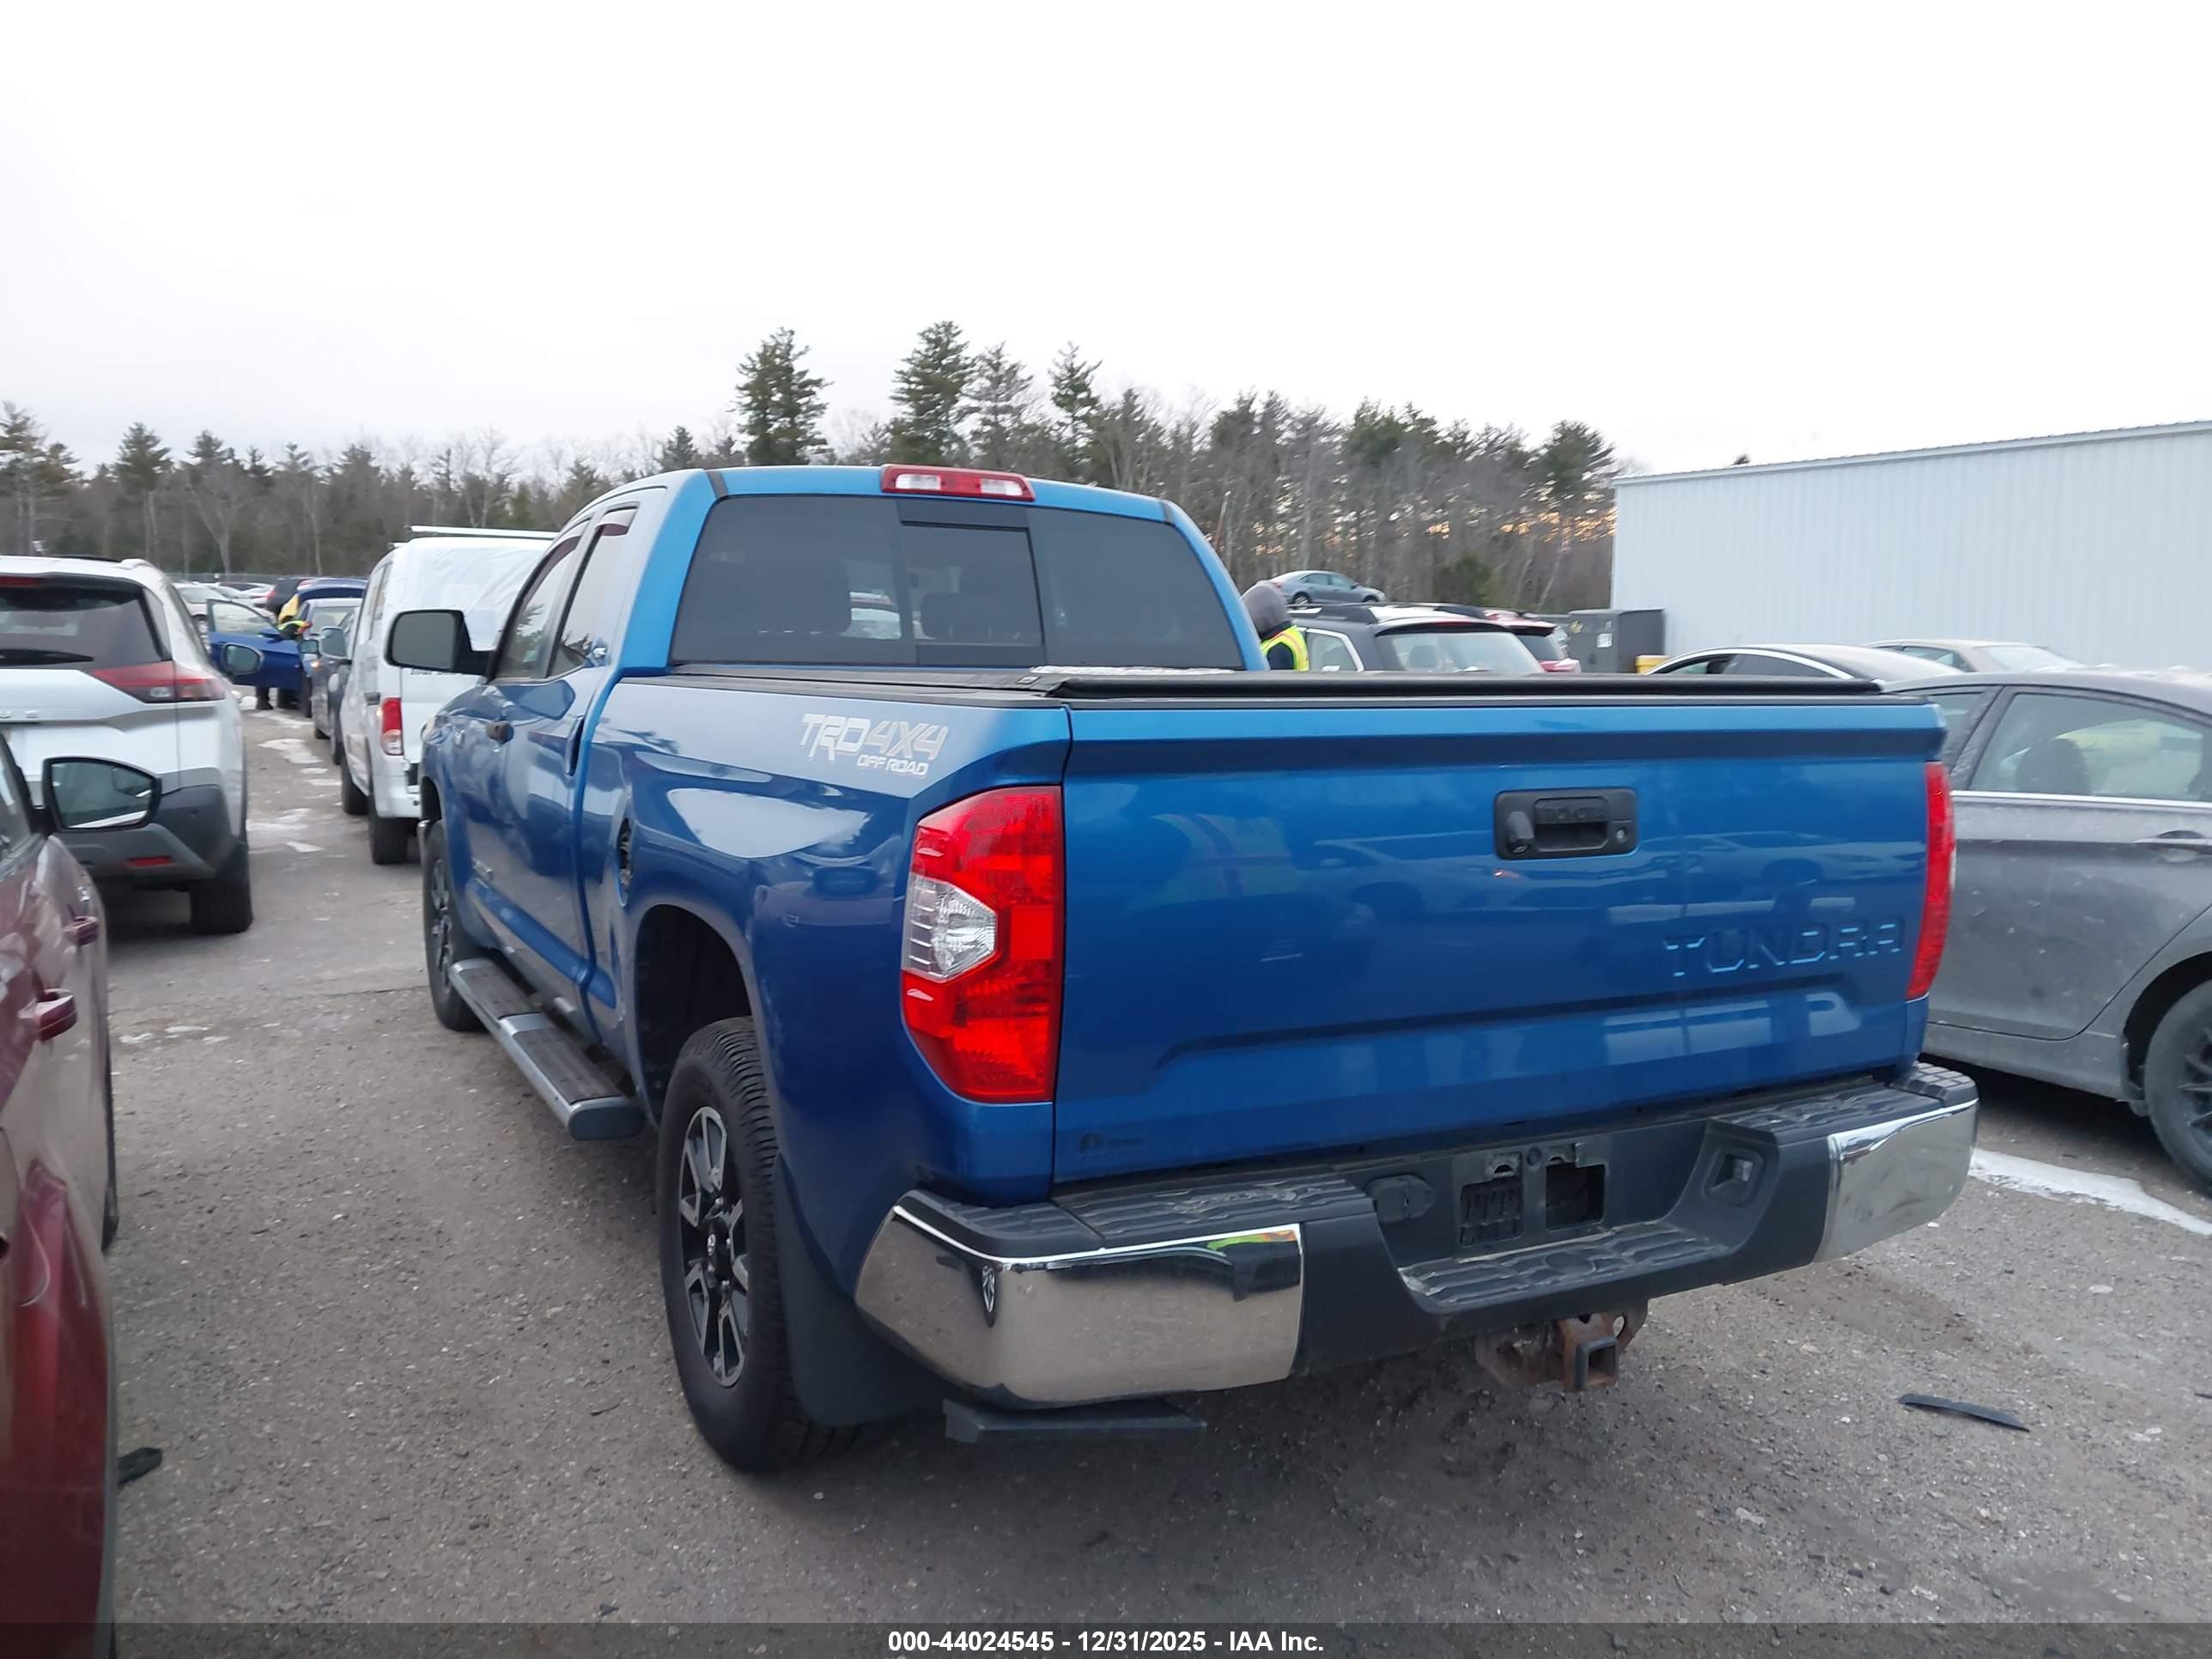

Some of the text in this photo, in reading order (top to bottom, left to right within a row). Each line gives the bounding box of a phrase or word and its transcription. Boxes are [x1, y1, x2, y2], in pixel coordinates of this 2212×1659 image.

[799, 713, 871, 762] TRD
[857, 754, 930, 777] OFF ROAD
[1663, 915, 1905, 977] TUNDRA
